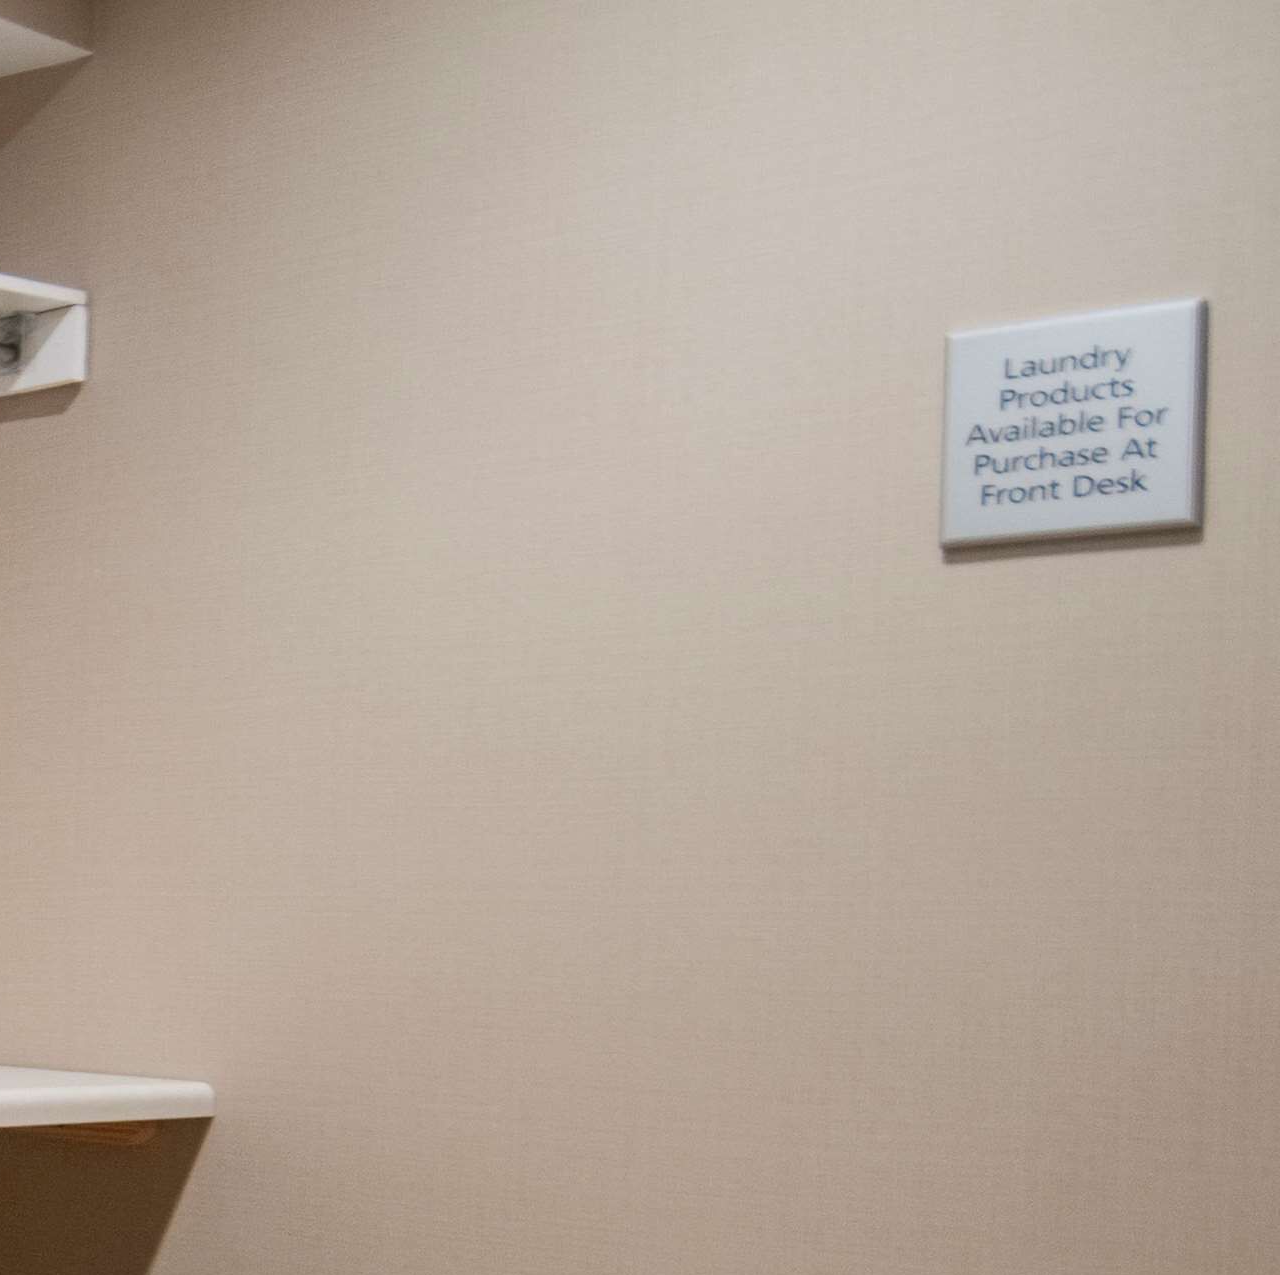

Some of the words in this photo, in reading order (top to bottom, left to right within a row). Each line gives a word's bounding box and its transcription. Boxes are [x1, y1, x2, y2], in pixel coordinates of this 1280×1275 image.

[1004, 344, 1131, 380] Laundry
[999, 377, 1135, 411] Products
[965, 411, 1105, 446] Available
[1118, 405, 1169, 429] For
[974, 445, 1109, 475] Purchase
[1121, 438, 1158, 460] At
[980, 480, 1060, 506] Front
[1073, 468, 1148, 498] Desk
